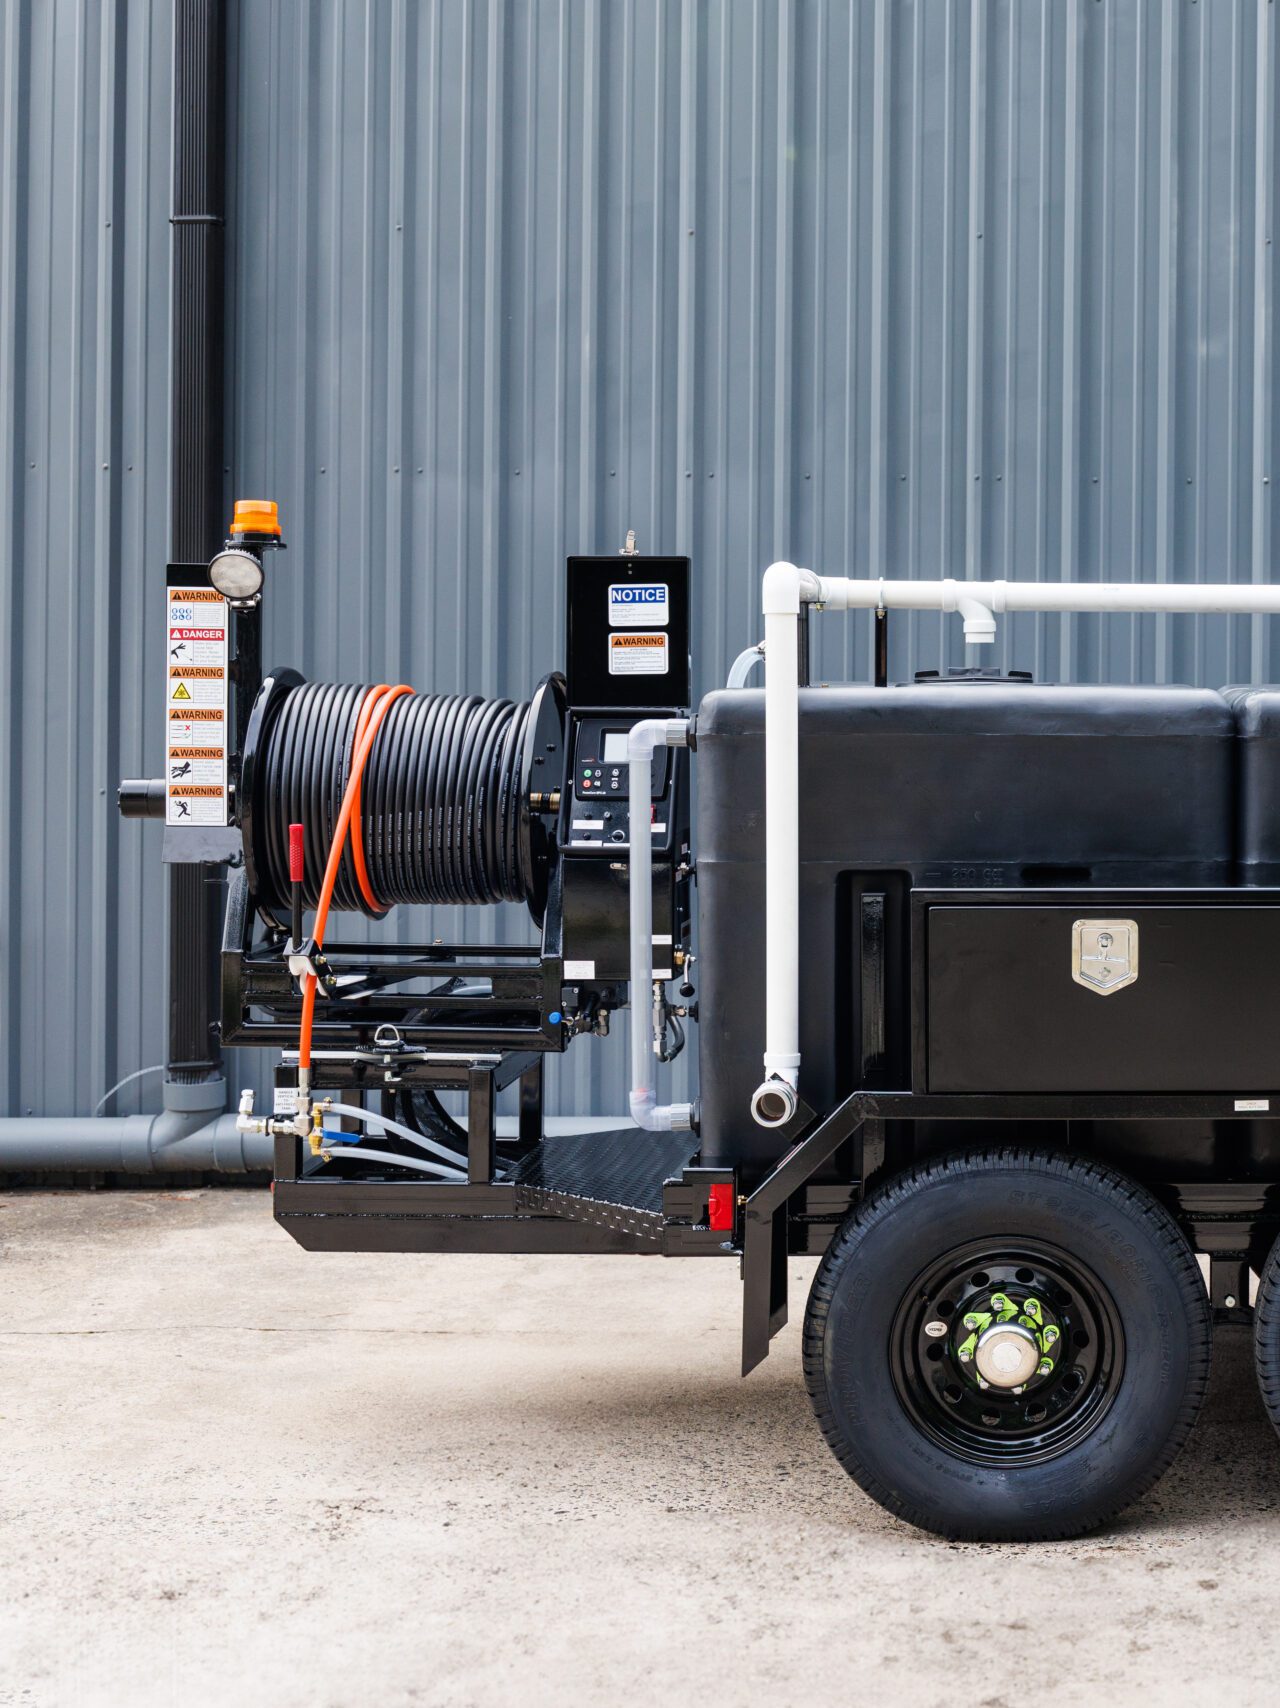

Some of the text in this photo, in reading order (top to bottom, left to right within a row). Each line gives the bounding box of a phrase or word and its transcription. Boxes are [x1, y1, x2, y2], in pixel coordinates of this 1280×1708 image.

[182, 591, 224, 601] WARNING
[612, 589, 665, 602] NOTICE
[182, 630, 223, 639] DANGER
[623, 637, 664, 646] WARNING
[181, 668, 223, 678] WARNING
[181, 710, 223, 720] WARNING
[180, 749, 223, 758] WARNING
[181, 787, 222, 796] WARNING
[838, 1273, 872, 1426] PROVIDER
